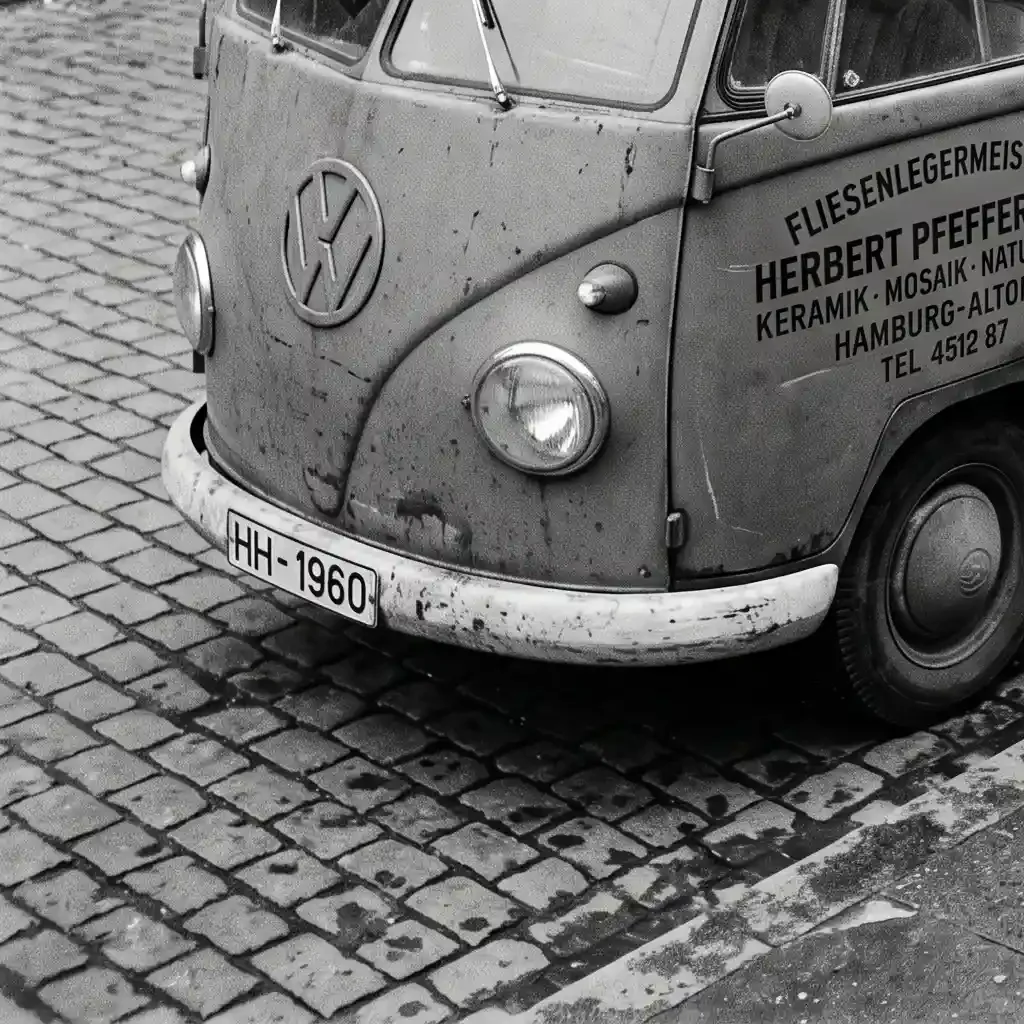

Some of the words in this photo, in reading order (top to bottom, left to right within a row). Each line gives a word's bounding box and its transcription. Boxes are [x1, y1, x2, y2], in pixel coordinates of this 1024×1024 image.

[754, 228, 903, 304] HERBERT
[756, 285, 870, 342] KERAMIK
[885, 256, 968, 306] MOSAIK
[881, 349, 921, 383] TEL
[930, 329, 978, 365] 4512
[984, 317, 1008, 349] 87
